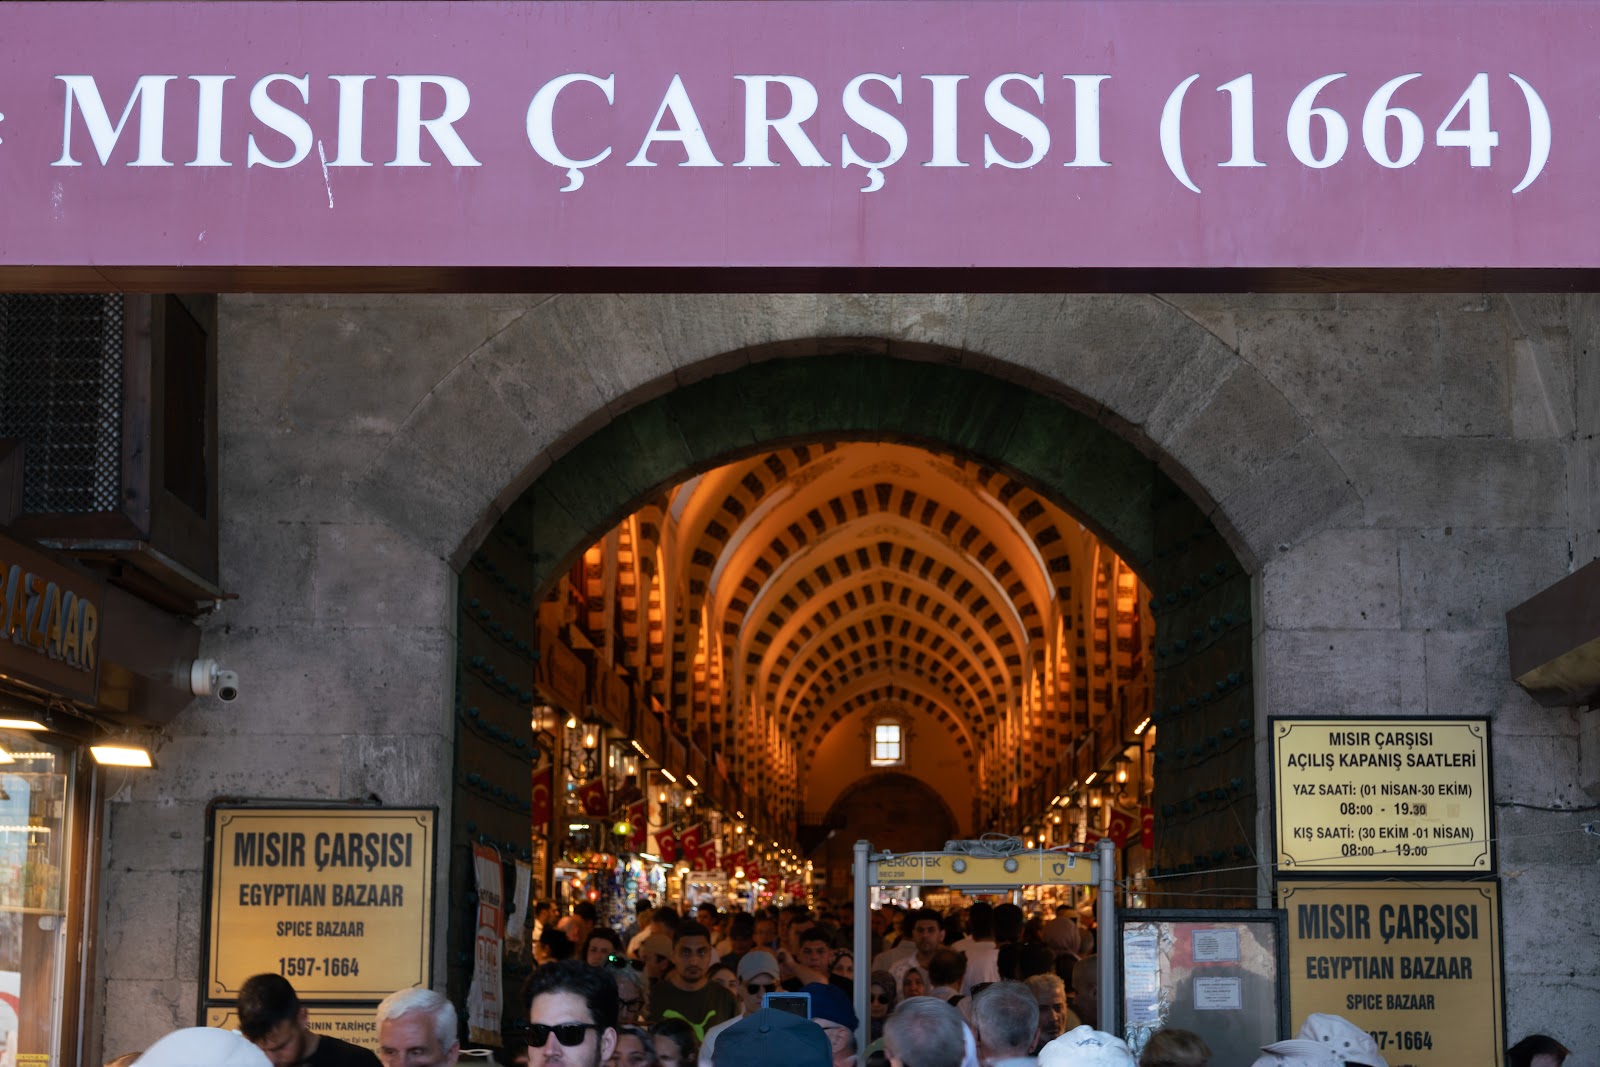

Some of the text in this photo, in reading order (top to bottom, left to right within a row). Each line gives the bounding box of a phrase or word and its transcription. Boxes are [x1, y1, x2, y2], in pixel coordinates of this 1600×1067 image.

[51, 72, 1552, 194] MISIR ÇARŞISI (1664)
[1330, 732, 1432, 750] MISIR ÇARŞISI
[1288, 750, 1476, 771] AÇILIŞ KAPANIŞ SAATLERİ
[1293, 781, 1473, 798] YAZ SAATİ: (01 NİSAN-30 EKİM)
[1340, 803, 1373, 816] 08:00
[1394, 803, 1427, 816] 19.30
[1293, 824, 1474, 842] KIŞ SAATİ: (30 EKİM -01 NİSAN)
[234, 832, 411, 872] MISIR ÇARŞISI
[1341, 843, 1375, 857] 08:00
[1395, 843, 1428, 857] 19.00
[239, 883, 404, 907] EGYPTIAN BAZAAR
[276, 920, 365, 937] SPICE BAZAAR
[1298, 903, 1478, 944] MISIR ÇARŞISI
[279, 957, 359, 977] 1597-1664
[1306, 956, 1473, 980] EGYPTIAN BAZAAR
[1346, 994, 1435, 1010] SPICE BAZAAR
[1365, 1031, 1433, 1051] 7-1664
